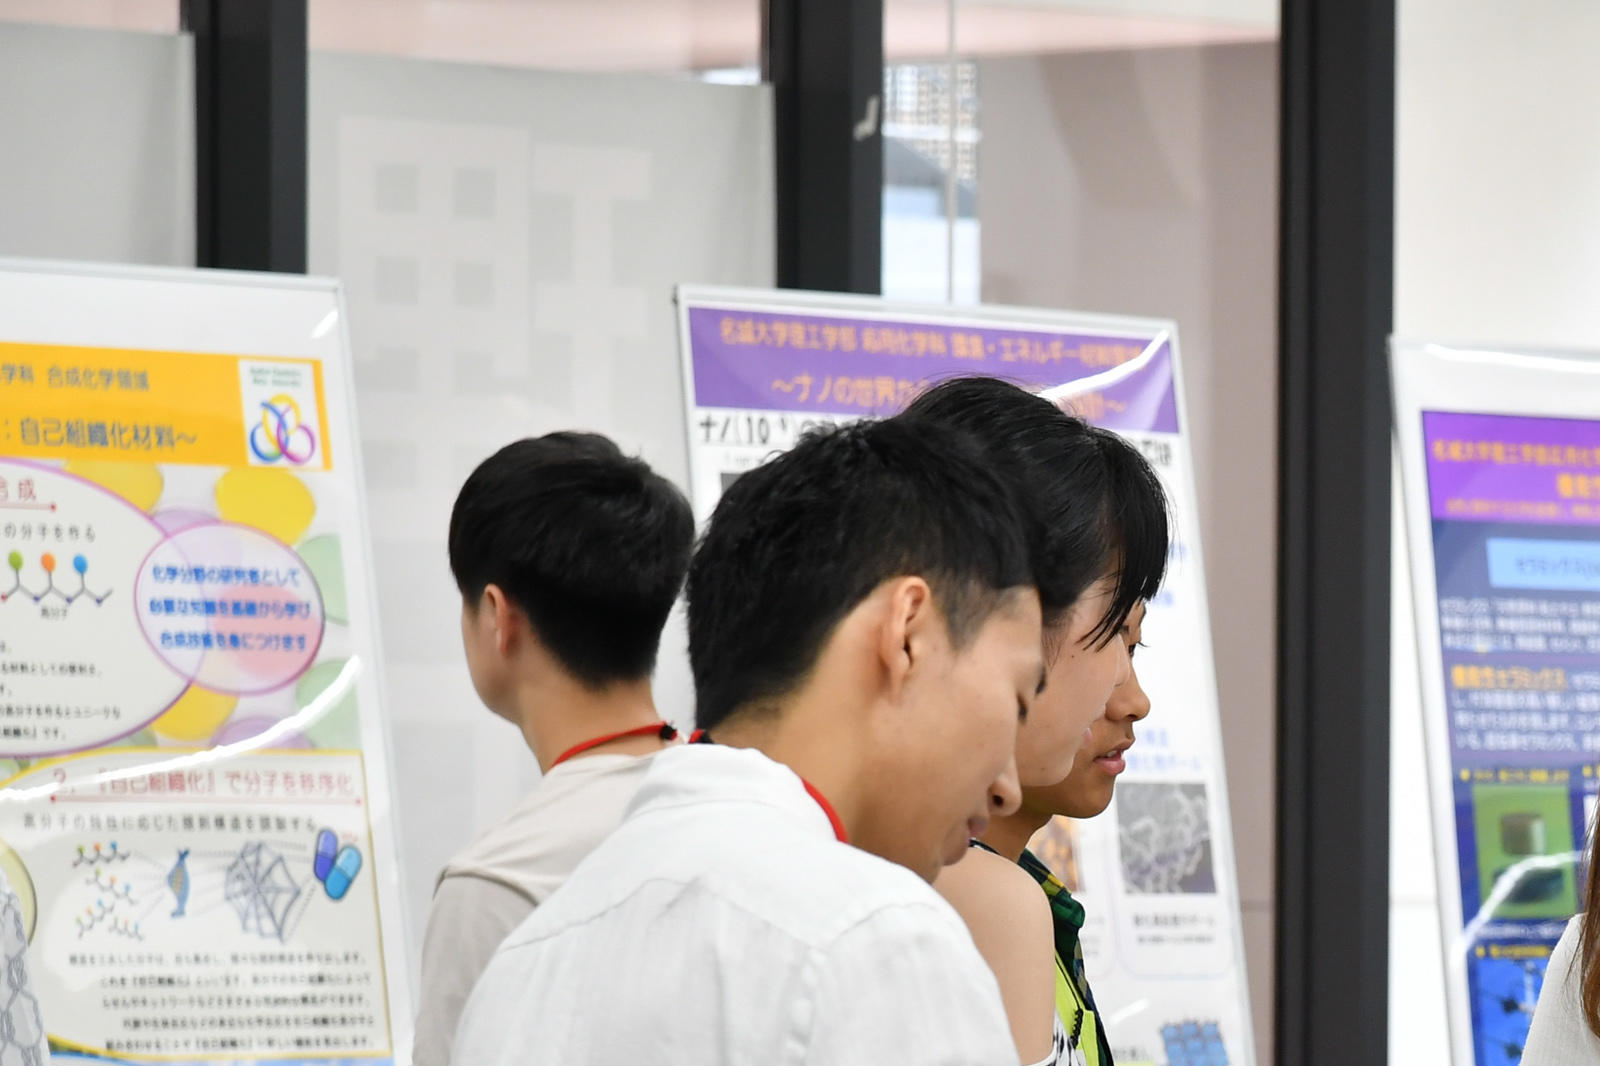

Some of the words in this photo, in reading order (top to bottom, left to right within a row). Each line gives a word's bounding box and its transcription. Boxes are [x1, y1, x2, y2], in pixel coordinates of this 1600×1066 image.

[0, 364, 34, 385] 学科
[0, 522, 96, 539] の分子を作る
